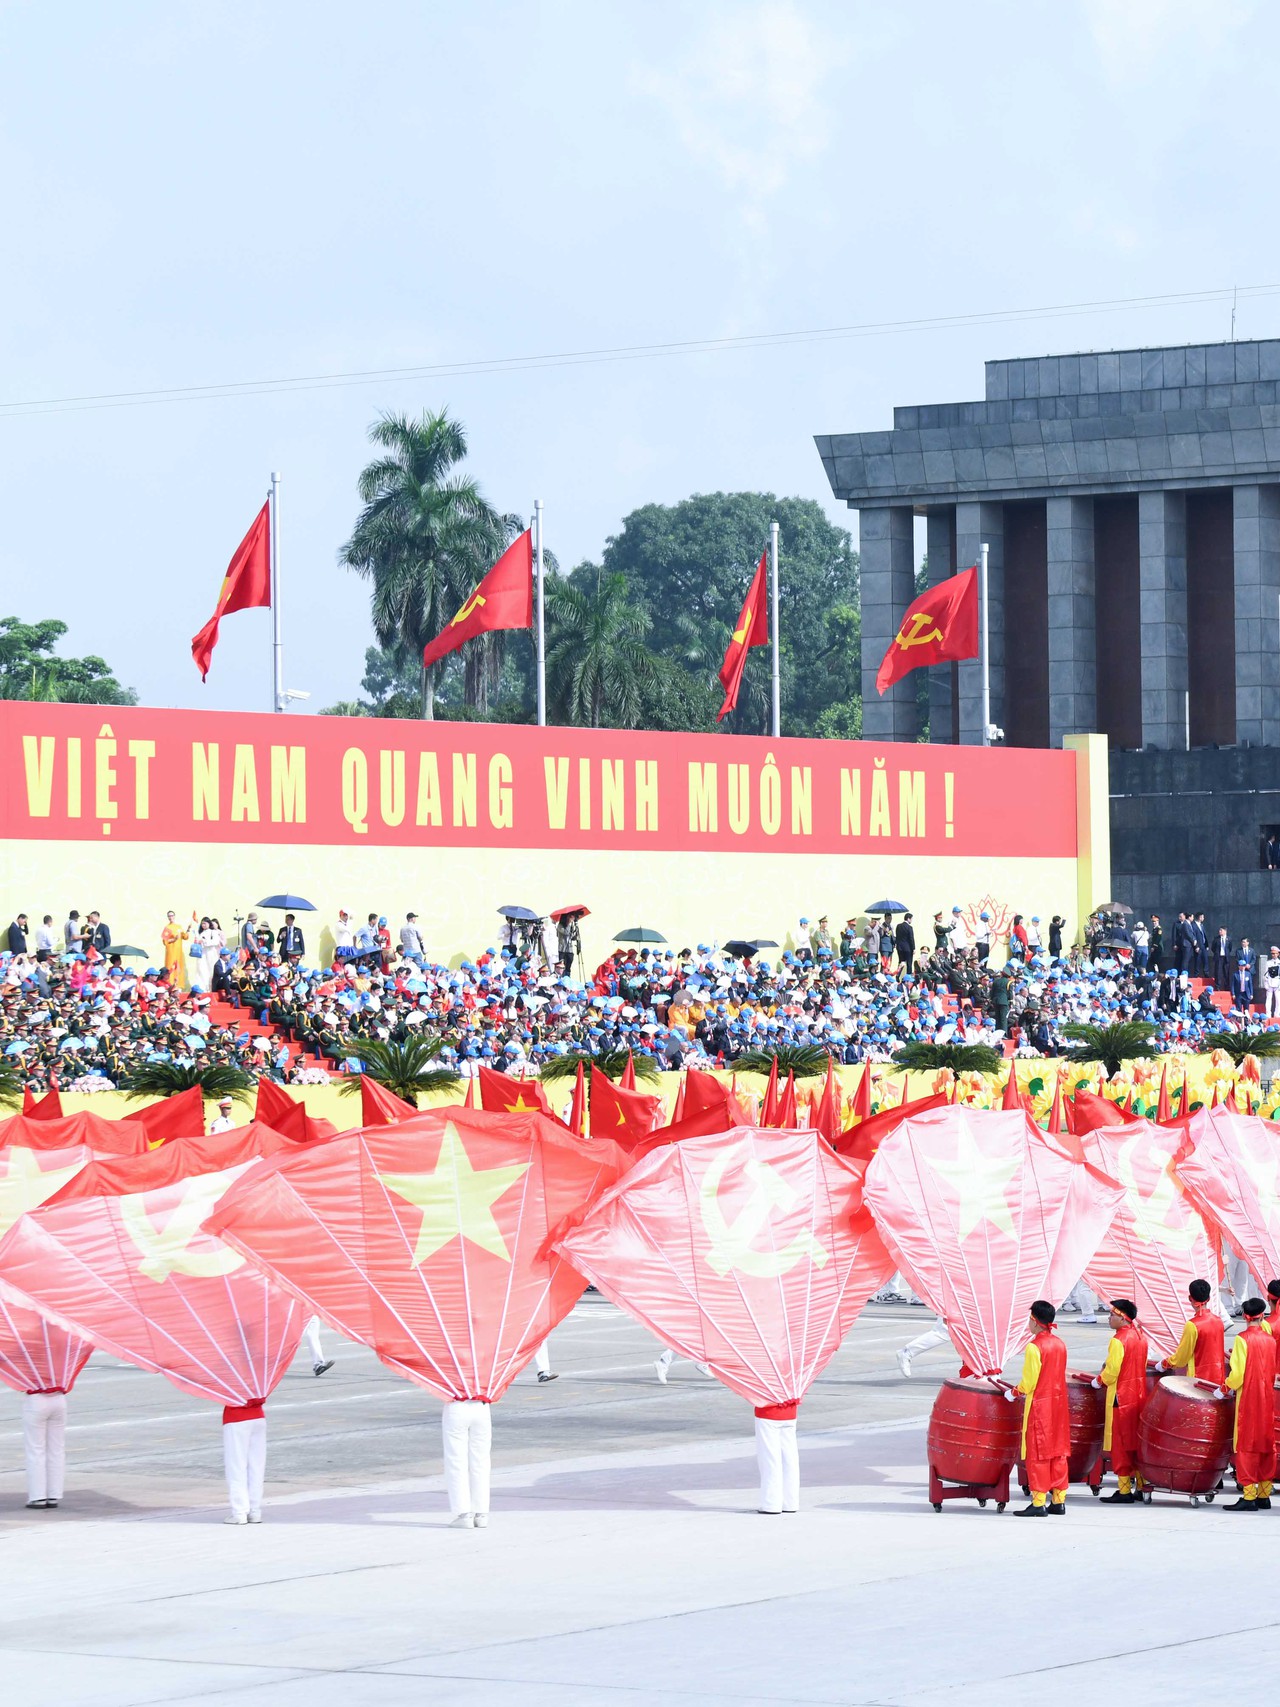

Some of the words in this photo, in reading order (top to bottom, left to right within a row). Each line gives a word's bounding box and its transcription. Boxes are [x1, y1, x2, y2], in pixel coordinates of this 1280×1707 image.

[22, 723, 156, 835] VIỆT
[192, 742, 307, 823] NAM
[341, 747, 514, 834] QUANG
[543, 756, 659, 832] VINH
[688, 752, 813, 836] MUÔN
[841, 757, 927, 838] NĂM
